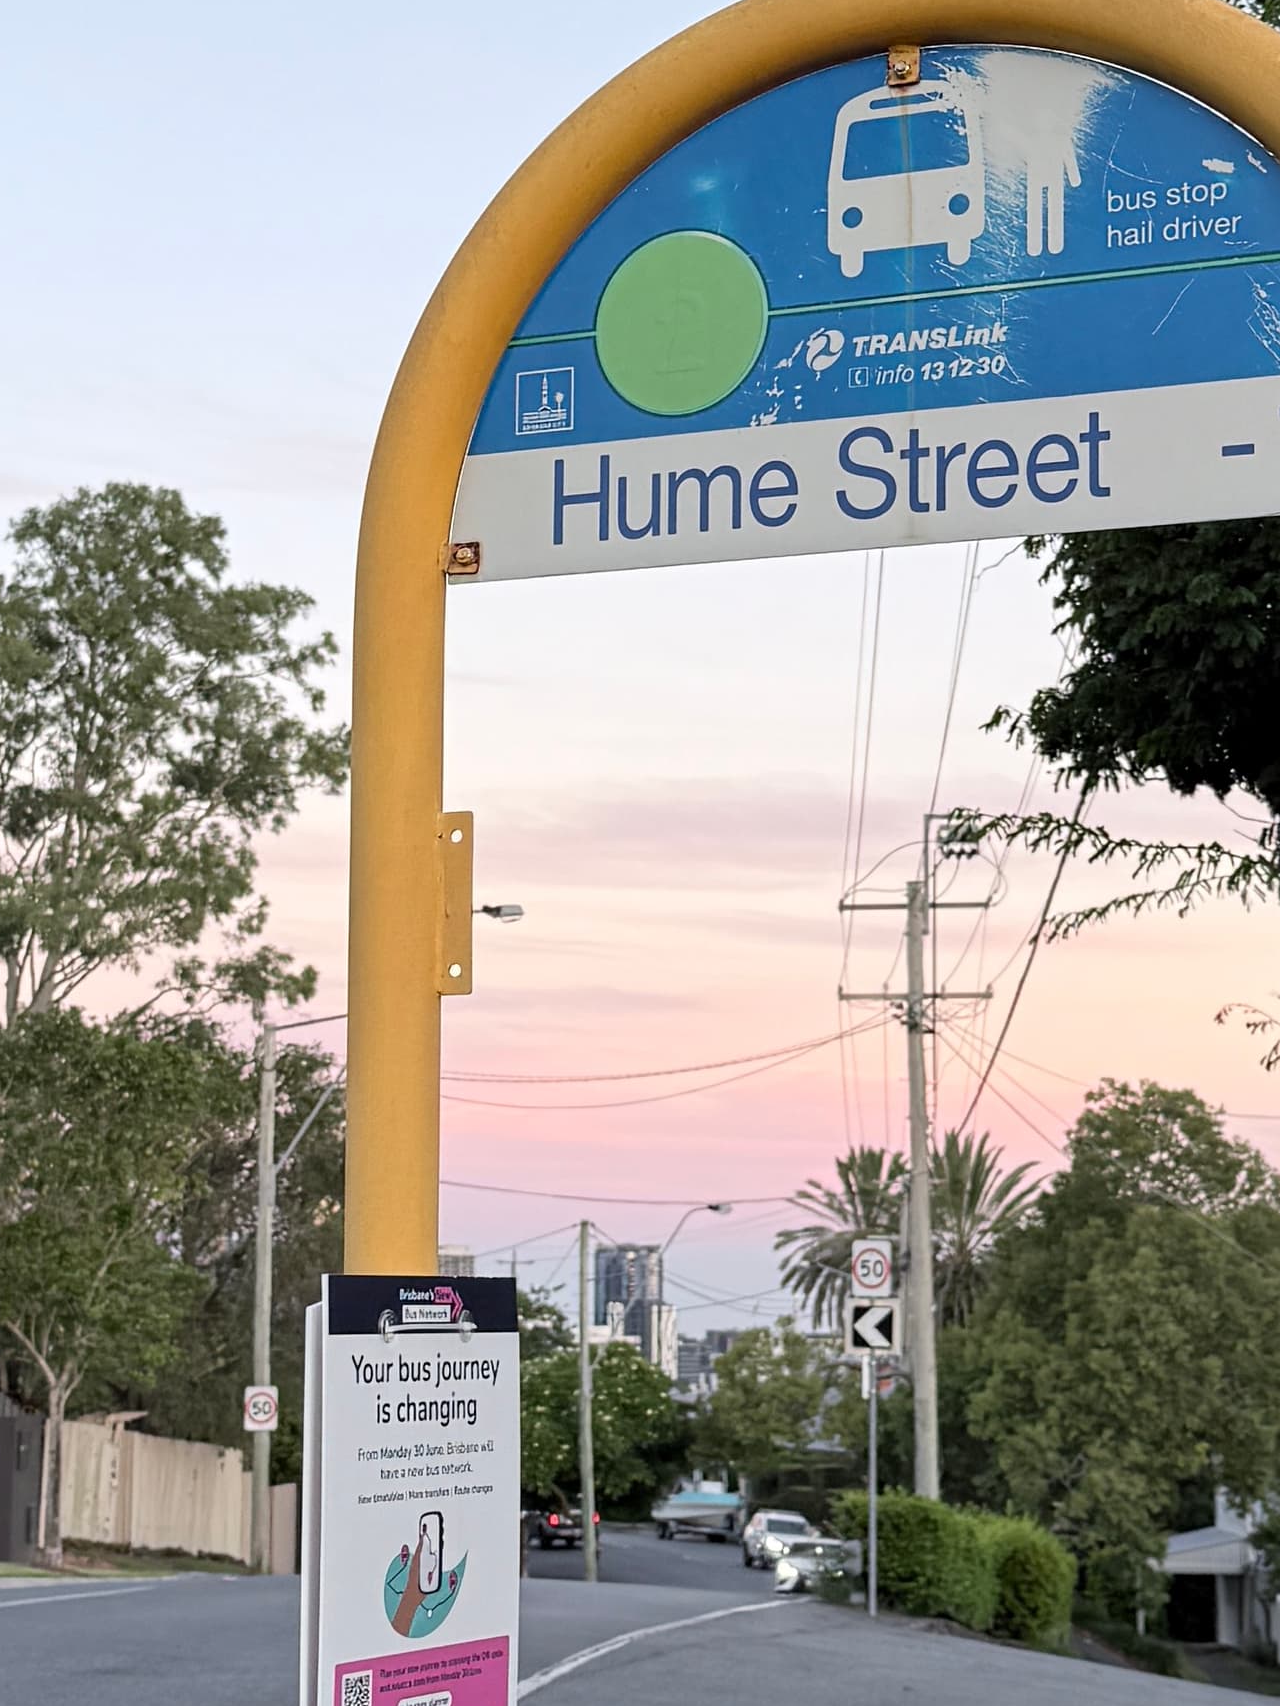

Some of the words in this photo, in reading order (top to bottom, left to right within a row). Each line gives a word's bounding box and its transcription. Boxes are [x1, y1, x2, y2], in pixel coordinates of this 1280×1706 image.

[1107, 190, 1157, 213] bus
[1166, 182, 1228, 207] stop
[1107, 220, 1153, 248] hail
[1163, 215, 1243, 241] driver
[852, 321, 1010, 358] TRANSLink
[875, 364, 915, 386] info
[553, 455, 798, 544] Hume
[836, 412, 1111, 521] Street
[861, 1259, 884, 1278] 50
[351, 1355, 393, 1384] Your
[399, 1354, 431, 1382] bus
[435, 1353, 500, 1388] journey
[252, 1401, 272, 1416] 50
[377, 1394, 391, 1424] is
[397, 1391, 478, 1427] changing
[380, 1445, 412, 1461] Monday
